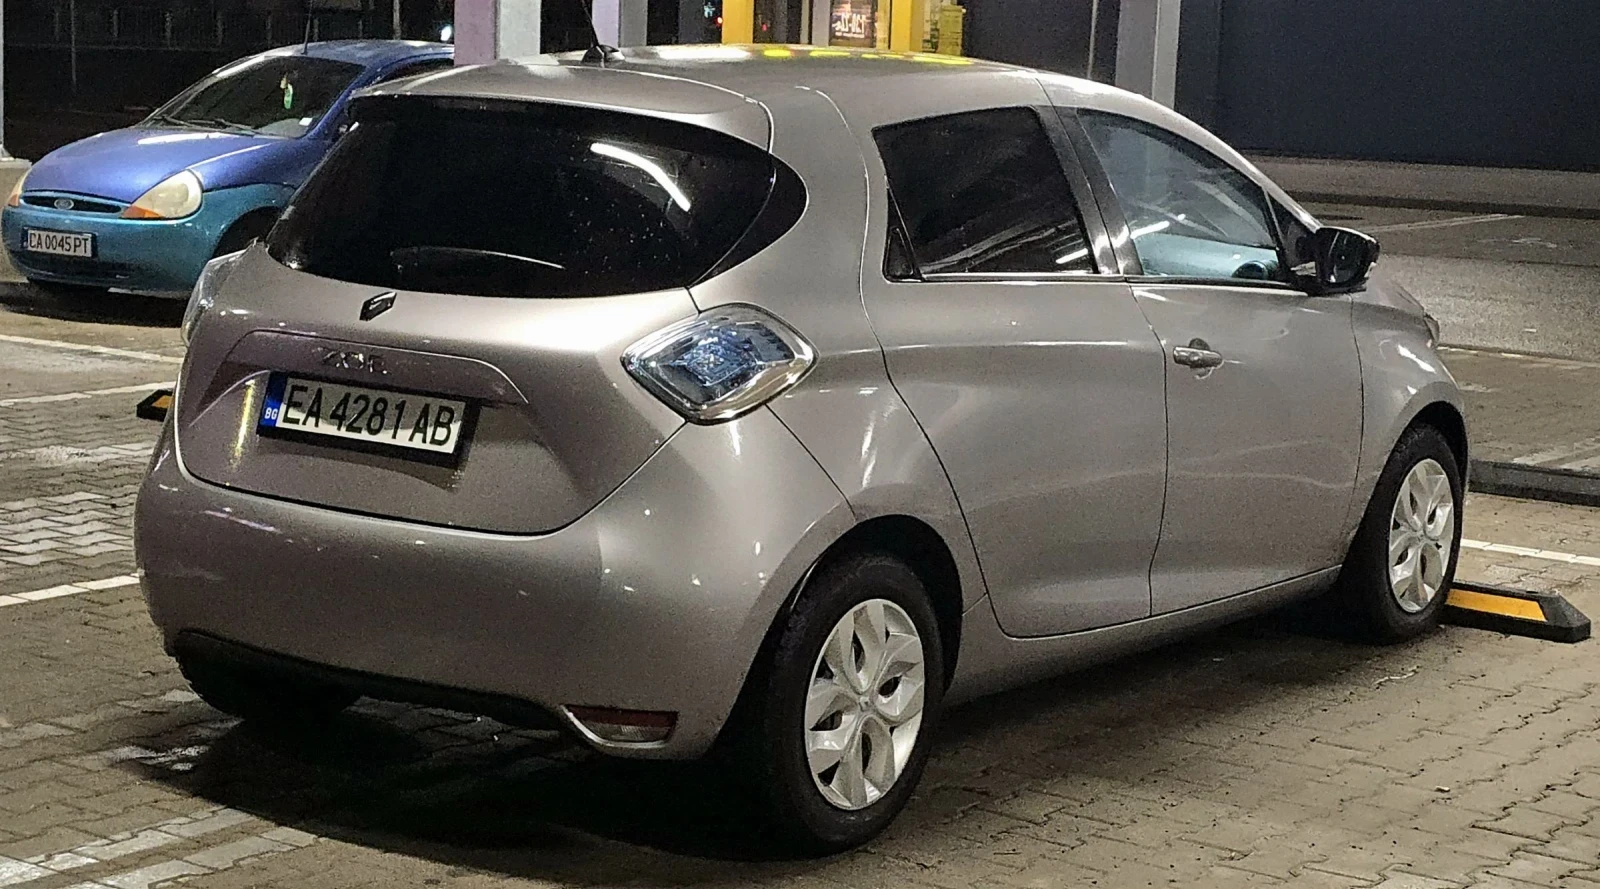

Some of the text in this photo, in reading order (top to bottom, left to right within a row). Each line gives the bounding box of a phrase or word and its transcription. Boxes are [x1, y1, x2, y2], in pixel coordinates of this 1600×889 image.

[29, 232, 89, 254] CA 0045 PT
[264, 407, 278, 420] BG
[282, 384, 455, 447] EA 4281 AB
